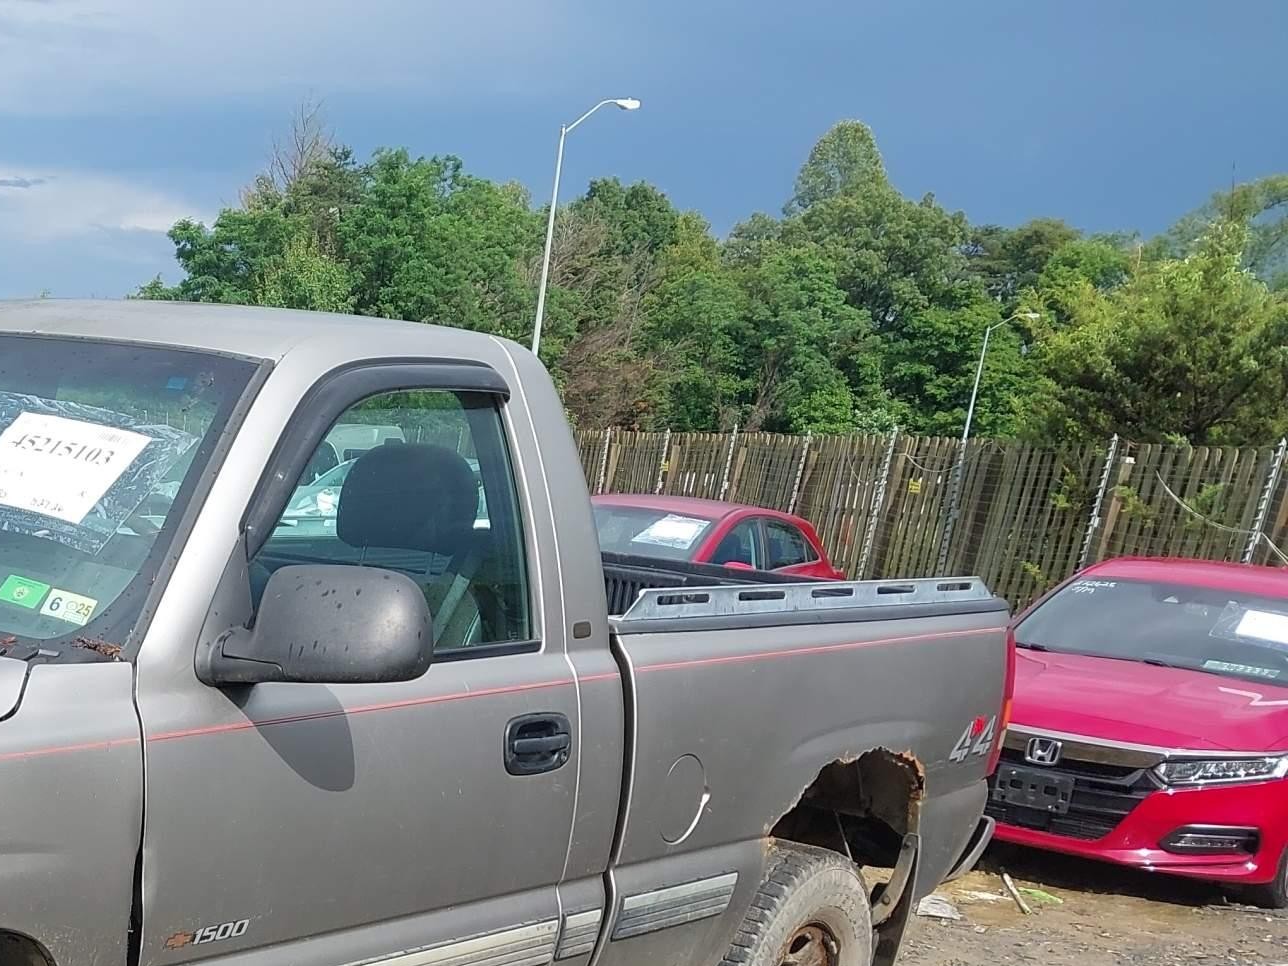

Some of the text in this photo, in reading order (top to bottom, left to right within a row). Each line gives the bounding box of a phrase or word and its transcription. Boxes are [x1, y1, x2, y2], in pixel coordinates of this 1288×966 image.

[10, 432, 116, 465] 45215103
[49, 596, 63, 612] 6
[75, 602, 93, 617] 25
[192, 918, 250, 945] 1500
